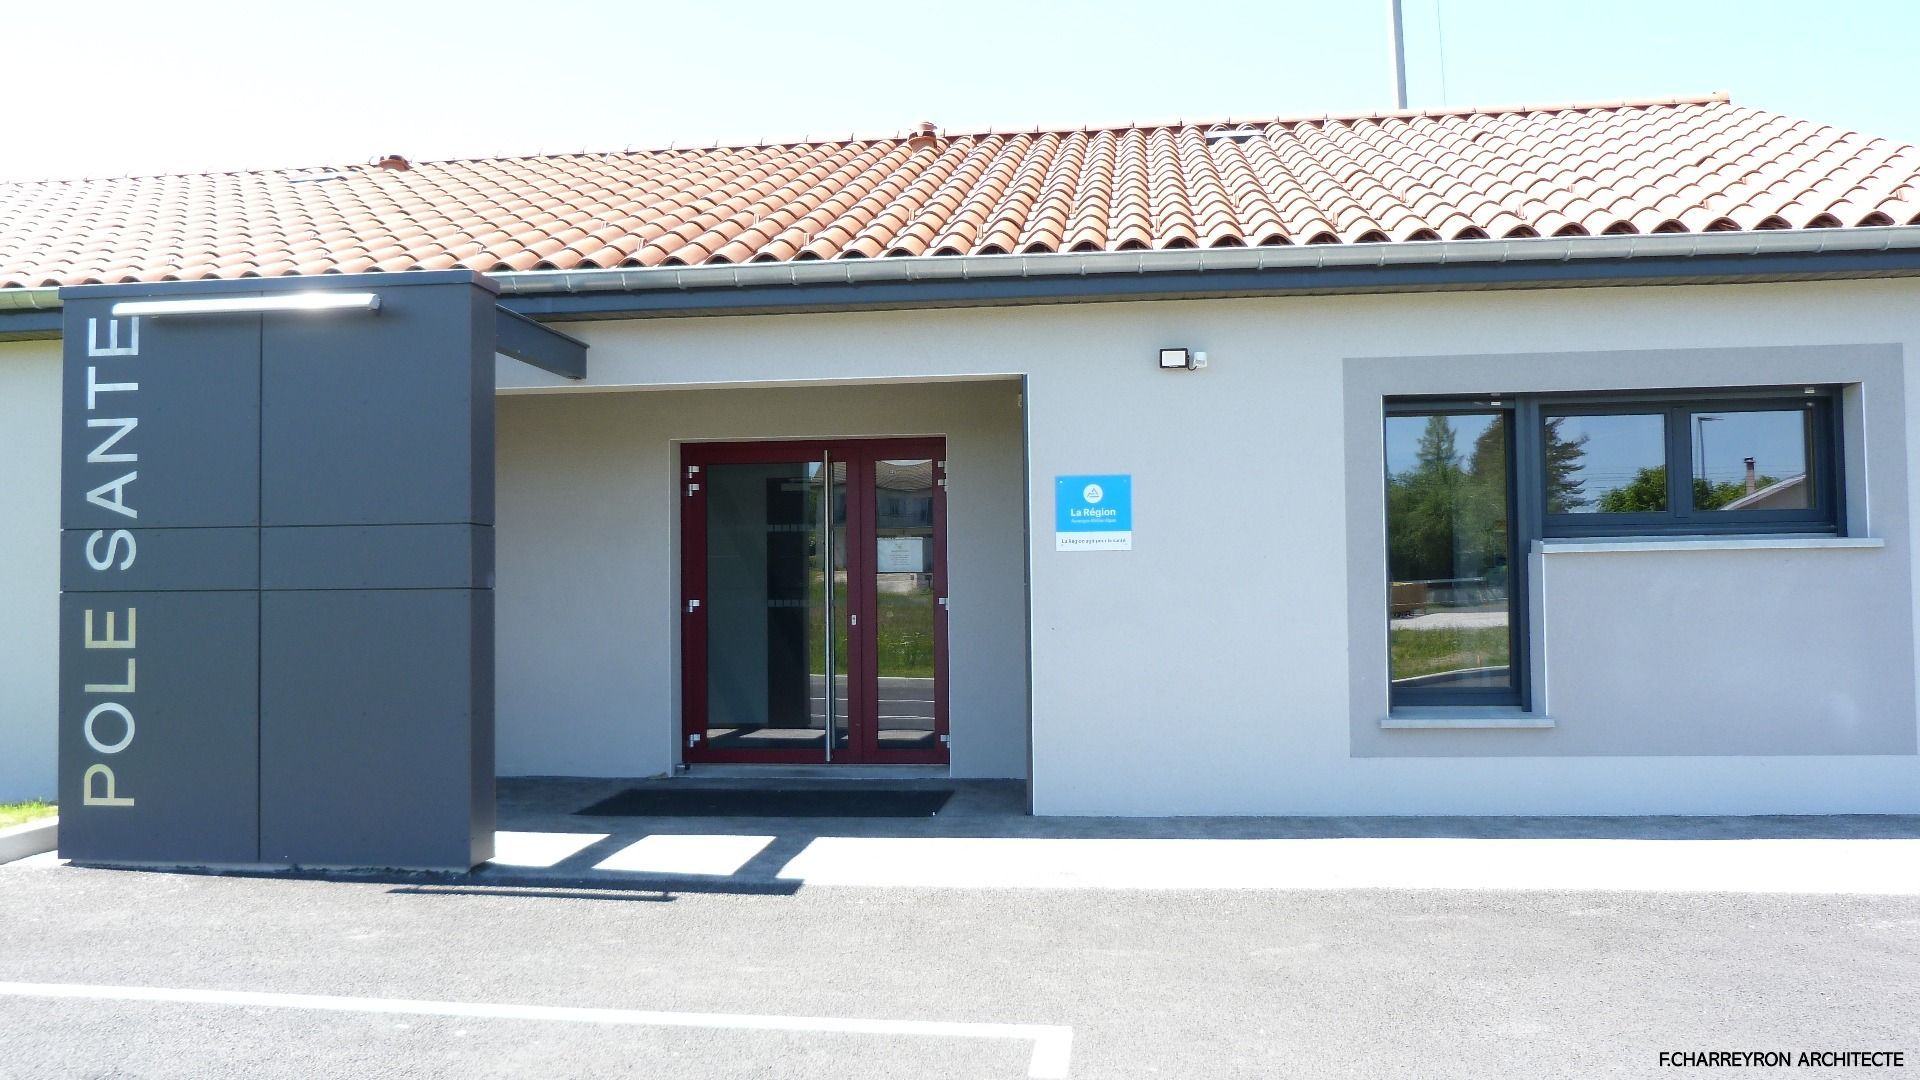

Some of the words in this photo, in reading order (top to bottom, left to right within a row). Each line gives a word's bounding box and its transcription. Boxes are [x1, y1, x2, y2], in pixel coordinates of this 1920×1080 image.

[86, 315, 139, 571] SANTE
[1070, 508, 1082, 517] La
[1083, 507, 1116, 518] Région
[83, 607, 136, 807] POLE
